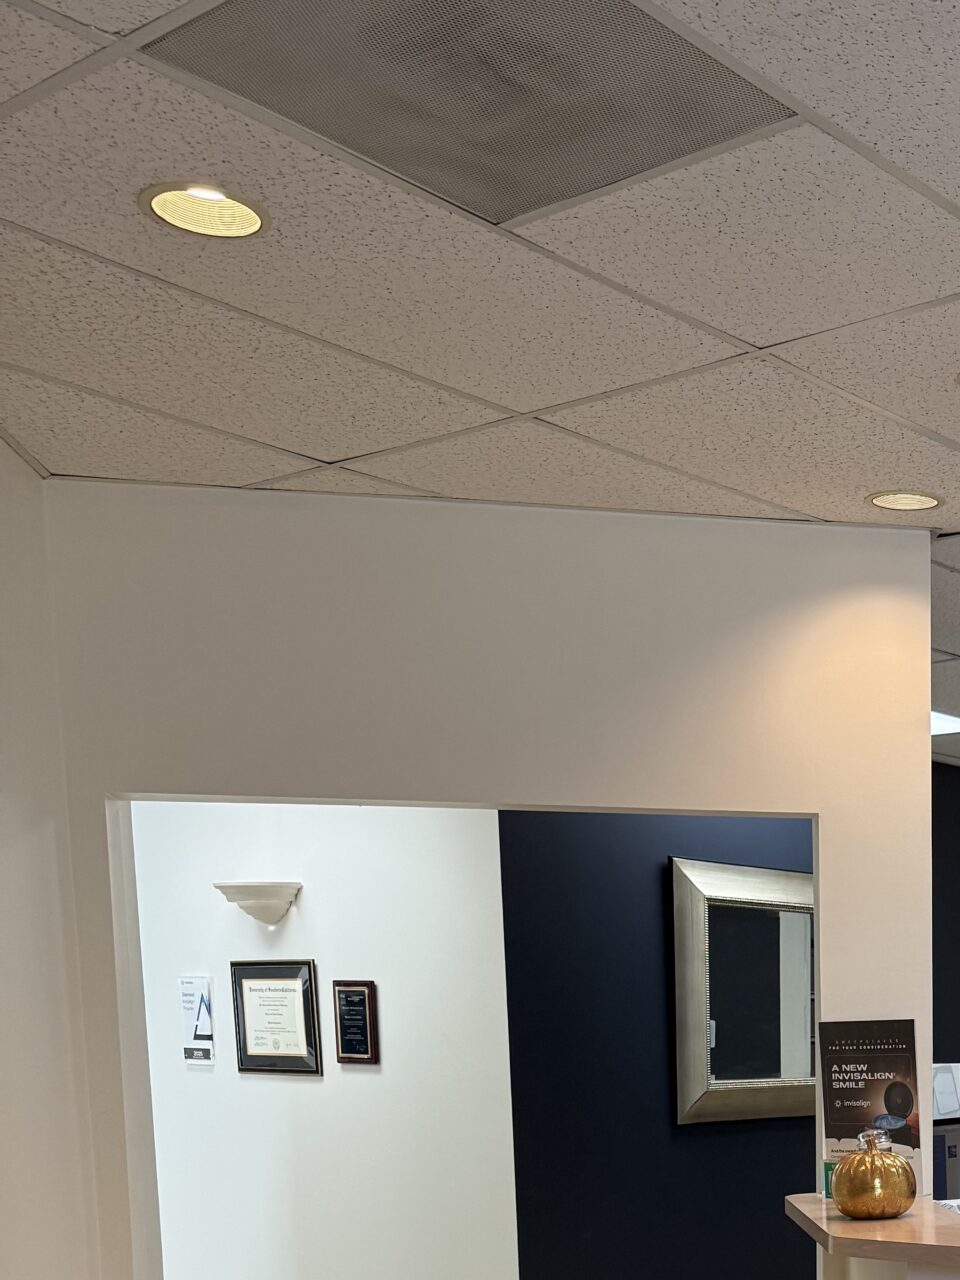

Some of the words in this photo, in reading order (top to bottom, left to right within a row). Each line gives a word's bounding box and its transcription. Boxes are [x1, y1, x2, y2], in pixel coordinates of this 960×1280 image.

[831, 1064, 839, 1072] A
[841, 1064, 868, 1072] NEW
[832, 1081, 865, 1089] SMILE
[843, 1100, 871, 1108] invisalign
